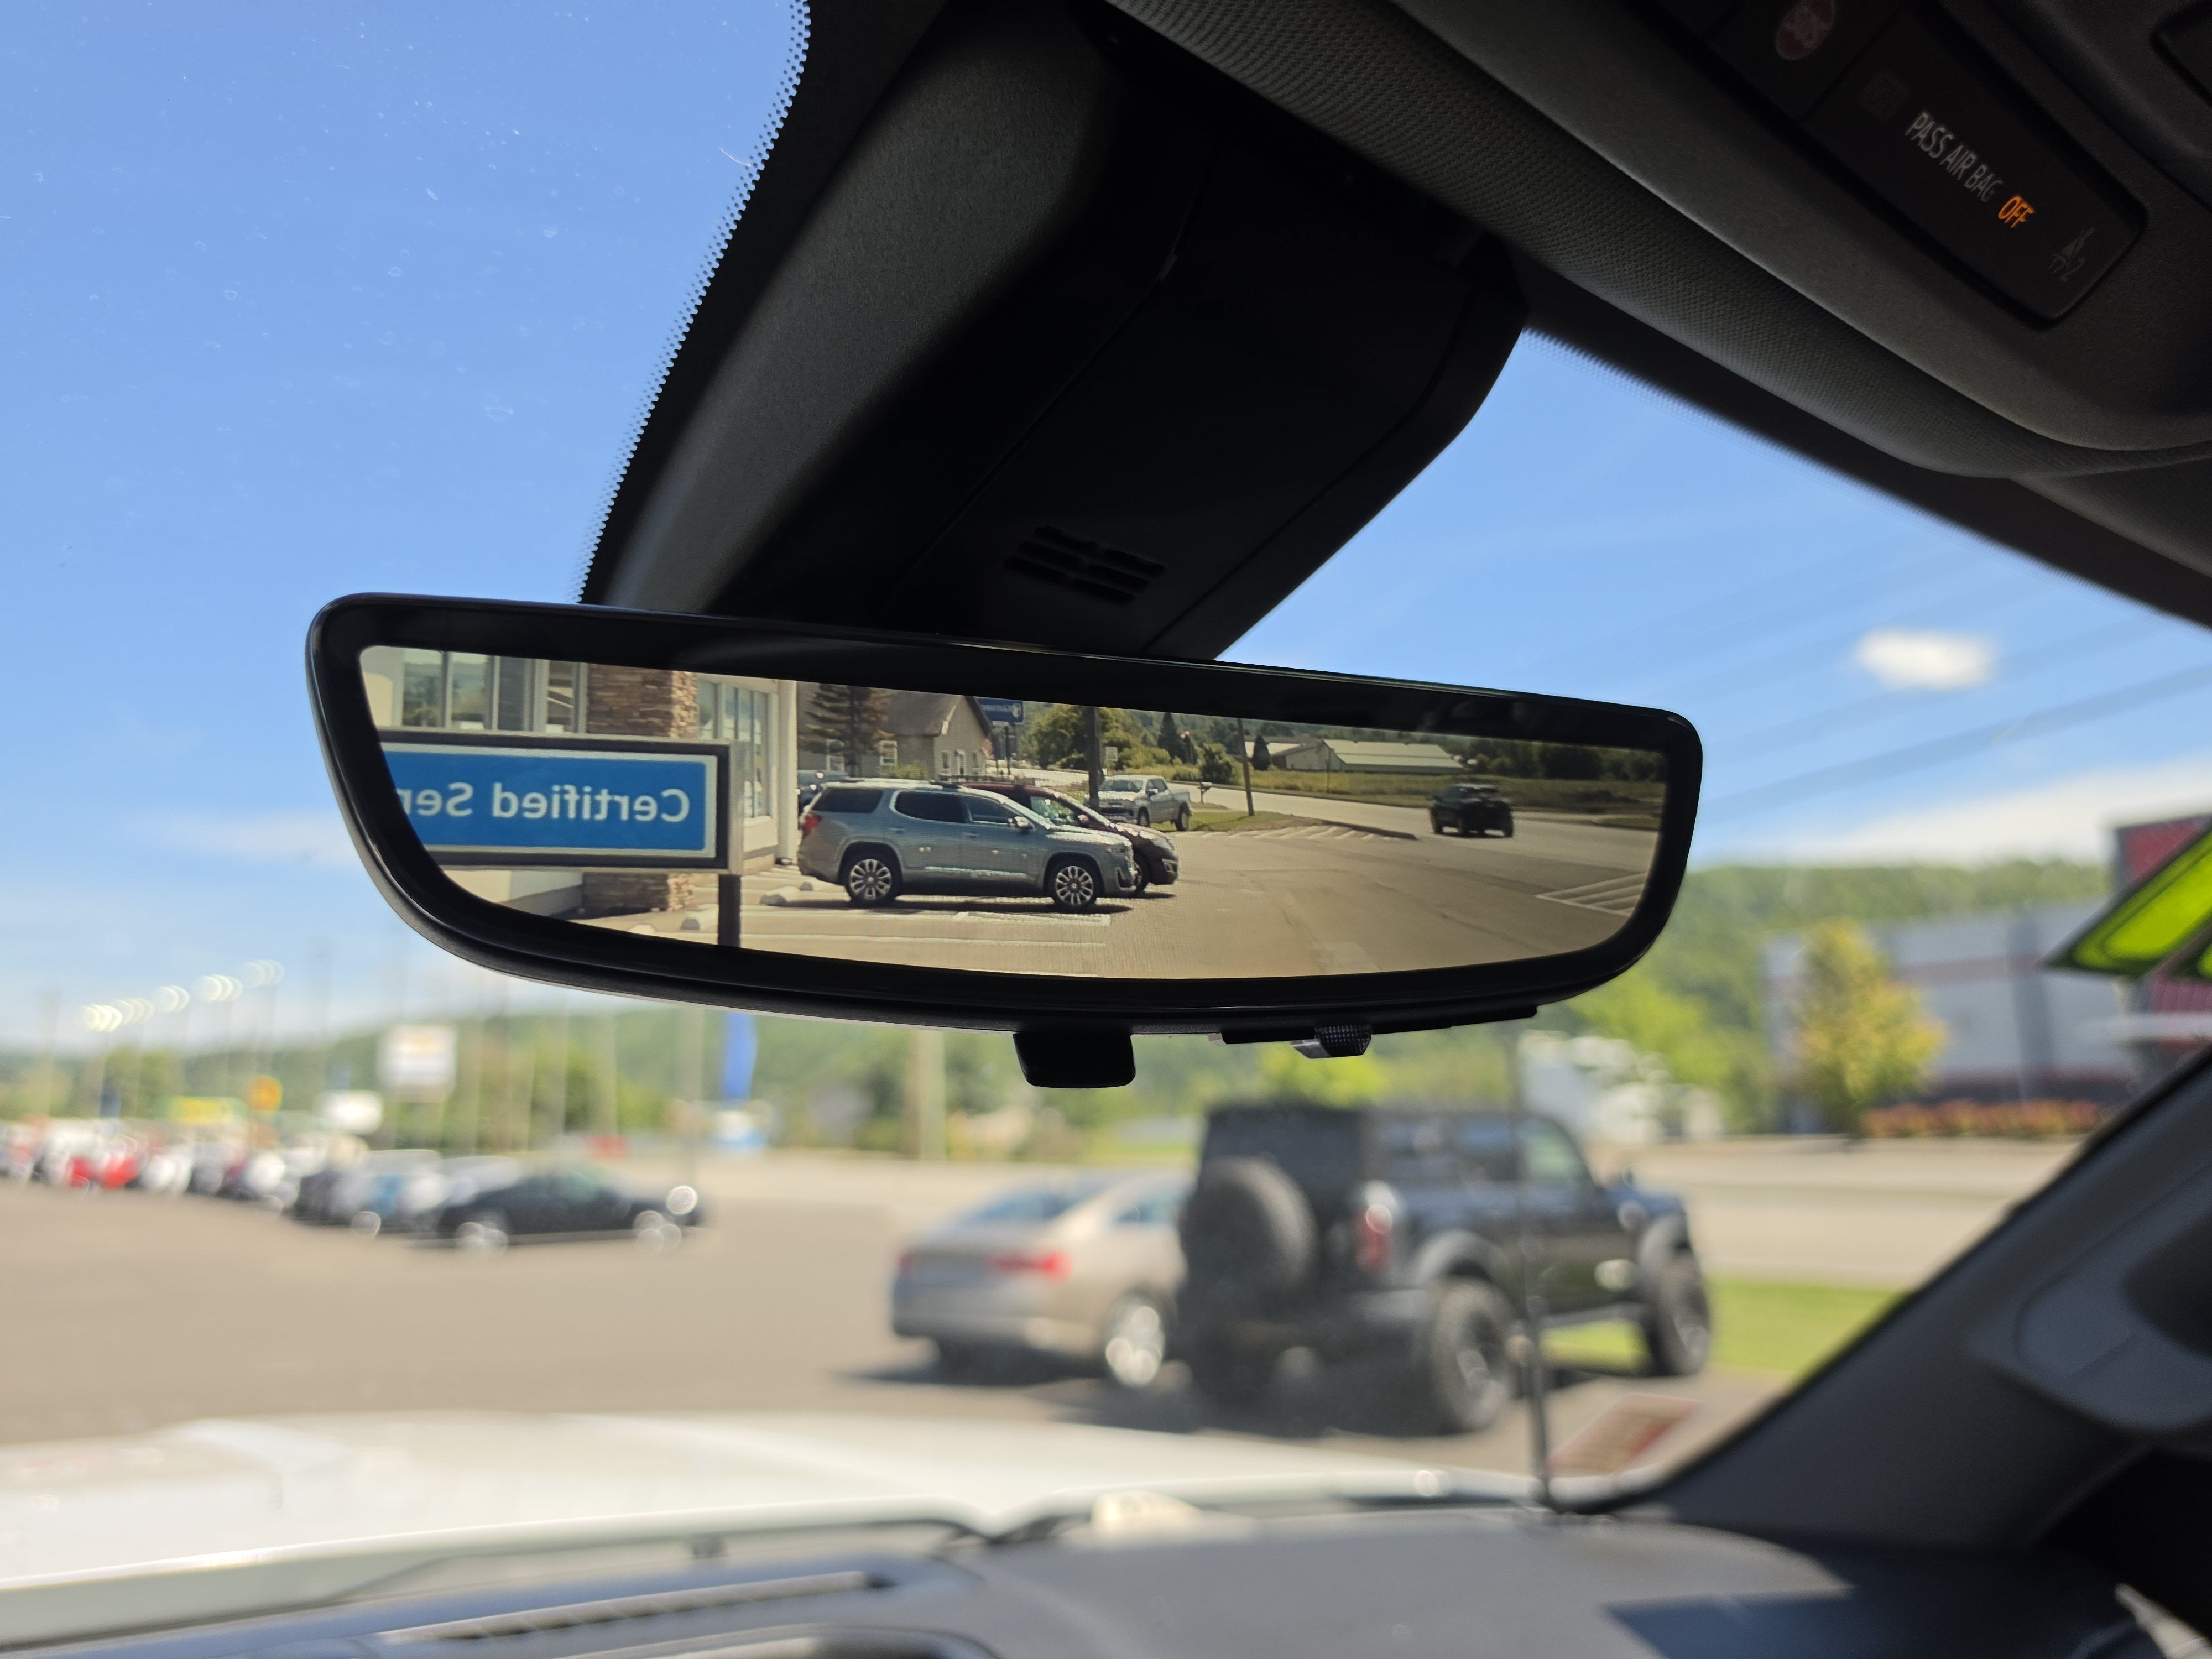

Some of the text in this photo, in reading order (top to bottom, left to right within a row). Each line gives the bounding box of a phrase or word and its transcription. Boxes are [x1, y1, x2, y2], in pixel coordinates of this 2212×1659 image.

[1904, 112, 2036, 229] PASS AIR BAG OFF
